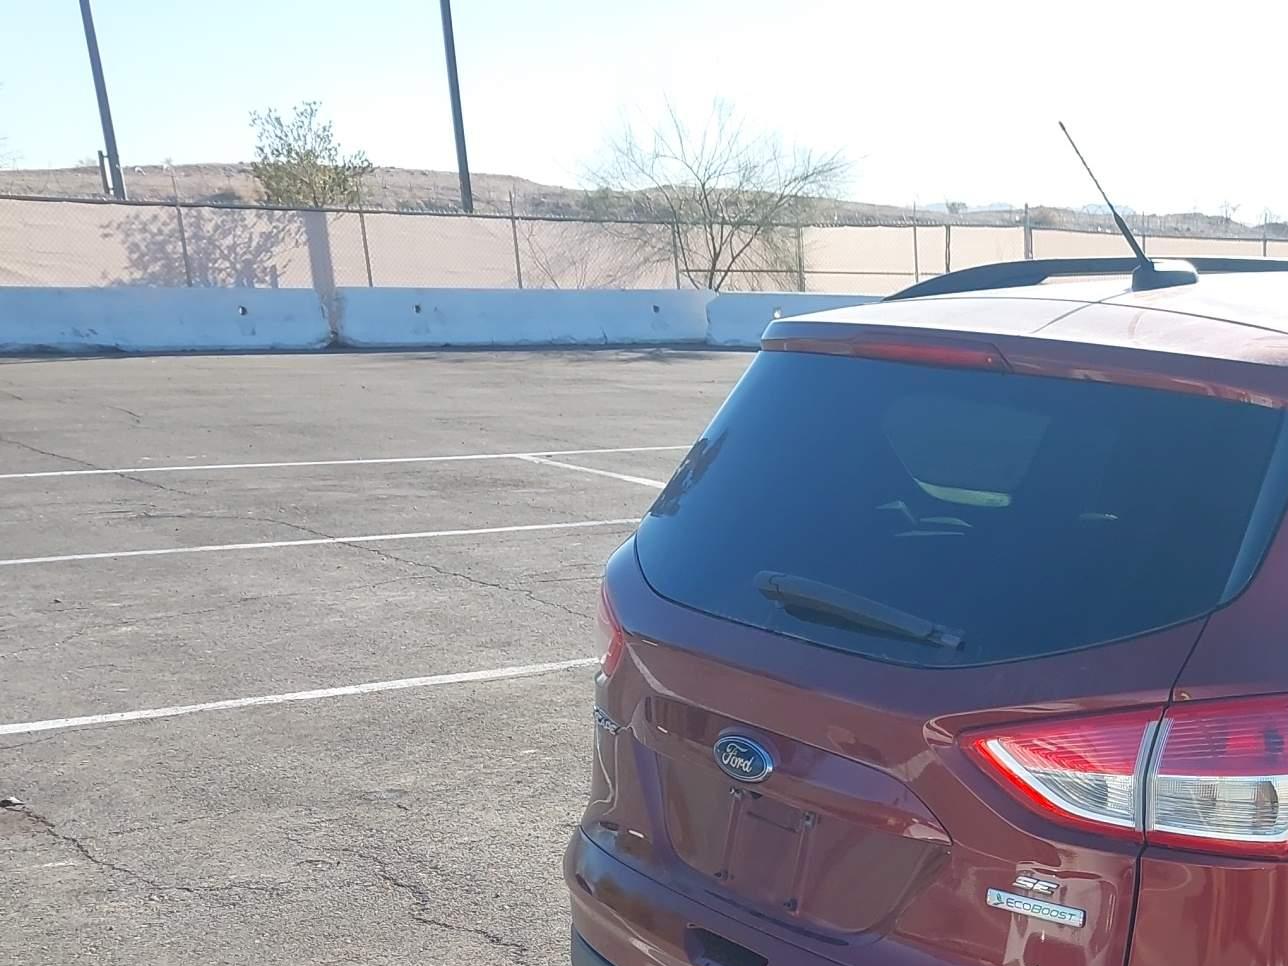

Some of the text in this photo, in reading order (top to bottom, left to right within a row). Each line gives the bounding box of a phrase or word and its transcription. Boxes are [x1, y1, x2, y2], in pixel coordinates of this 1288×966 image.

[722, 743, 754, 772] Ford
[1012, 876, 1060, 895] SE
[1006, 898, 1077, 921] ECOBOOST
